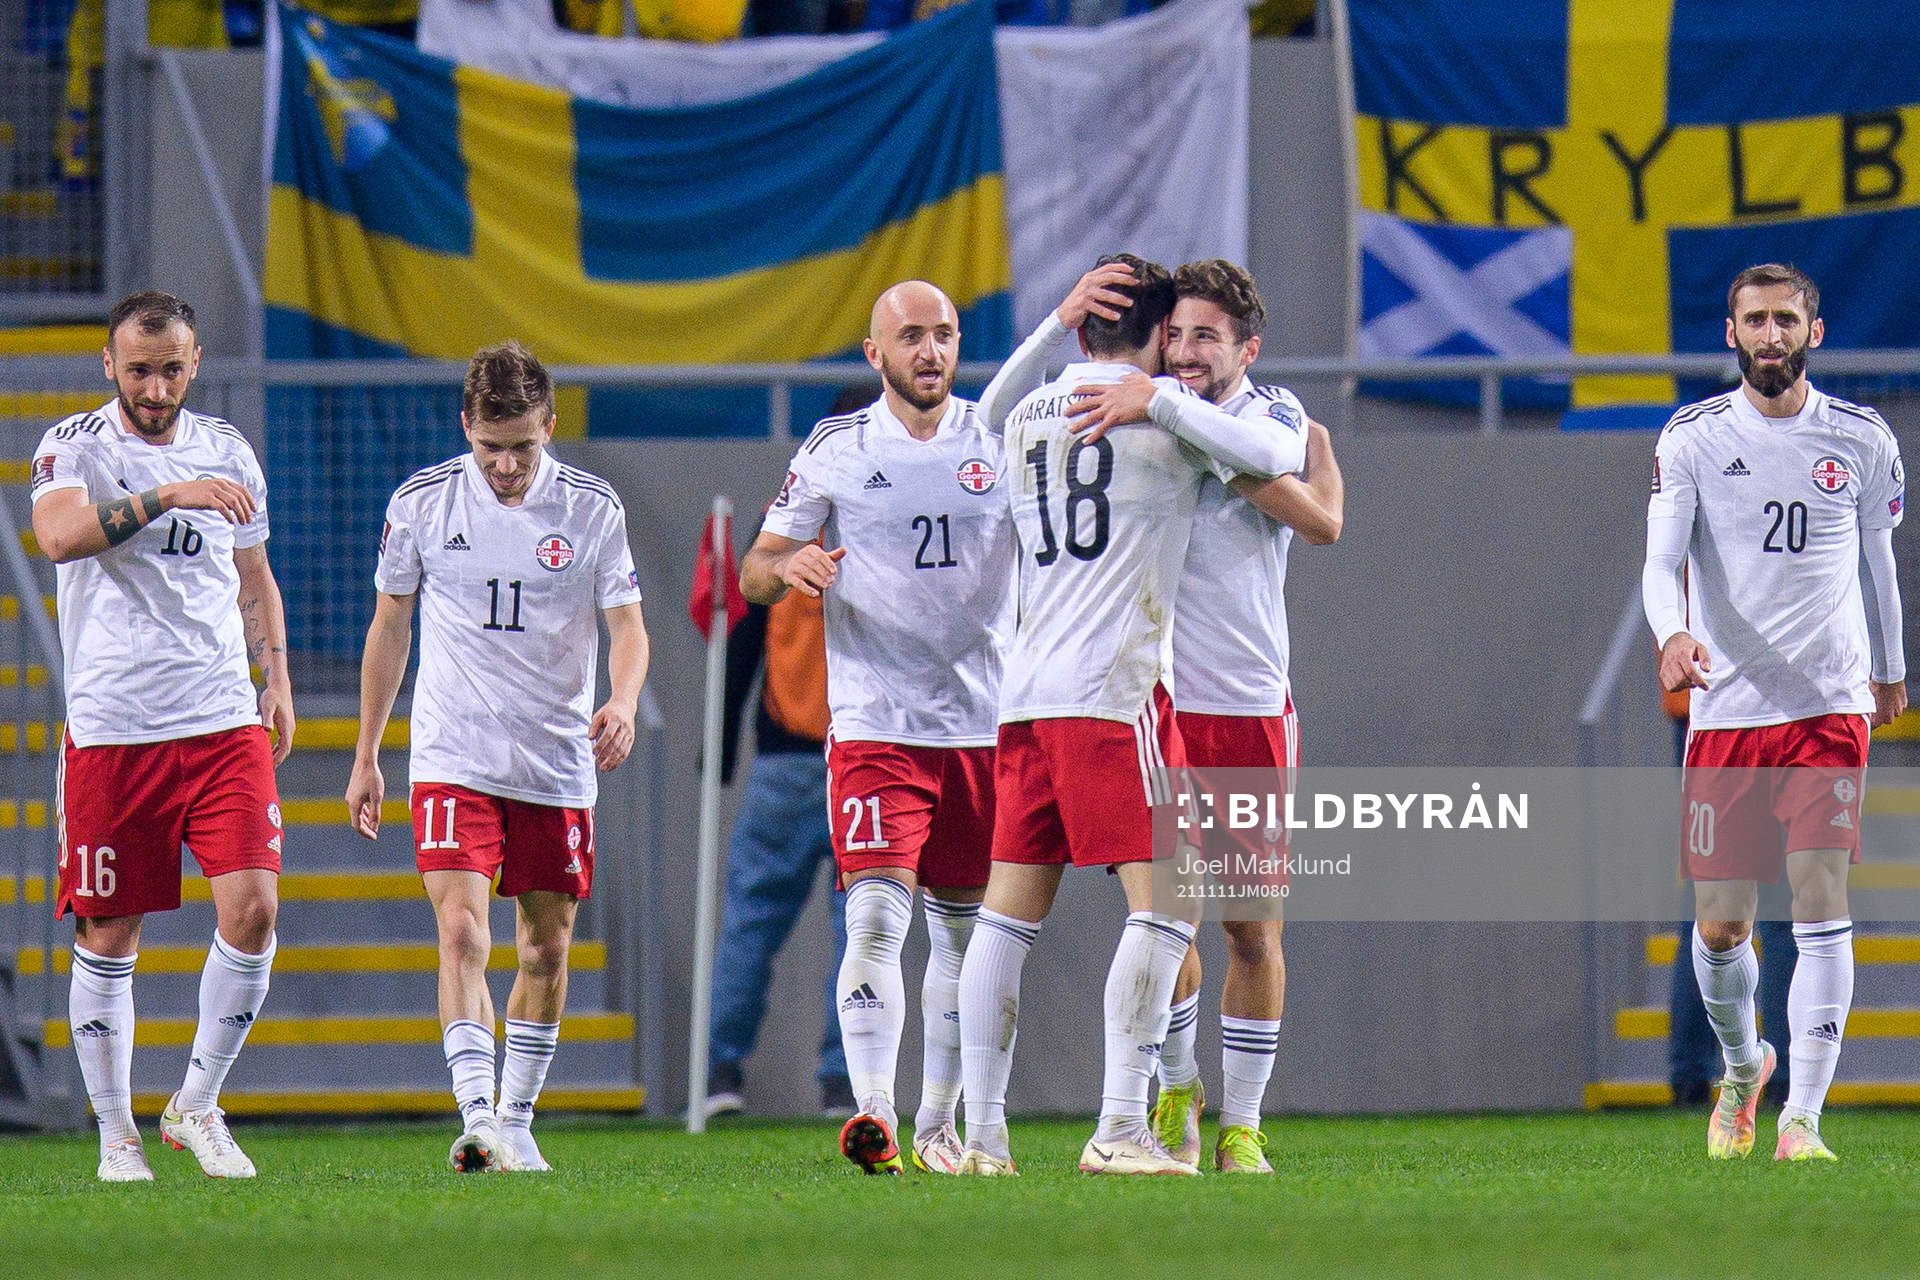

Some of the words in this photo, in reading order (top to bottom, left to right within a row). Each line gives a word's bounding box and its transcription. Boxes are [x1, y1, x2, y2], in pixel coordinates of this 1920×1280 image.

[863, 481, 892, 490] adidas
[958, 472, 995, 481] Georgia
[1026, 433, 1114, 567] 18
[1812, 470, 1849, 481] Georgia
[160, 516, 201, 557] 16
[537, 547, 573, 559] Georgia
[911, 514, 957, 569] 21
[1763, 501, 1807, 553] 20
[483, 578, 525, 632] 11
[420, 798, 460, 850] 11
[842, 796, 889, 851] 21
[1689, 800, 1715, 857] 20
[76, 845, 116, 897] 16
